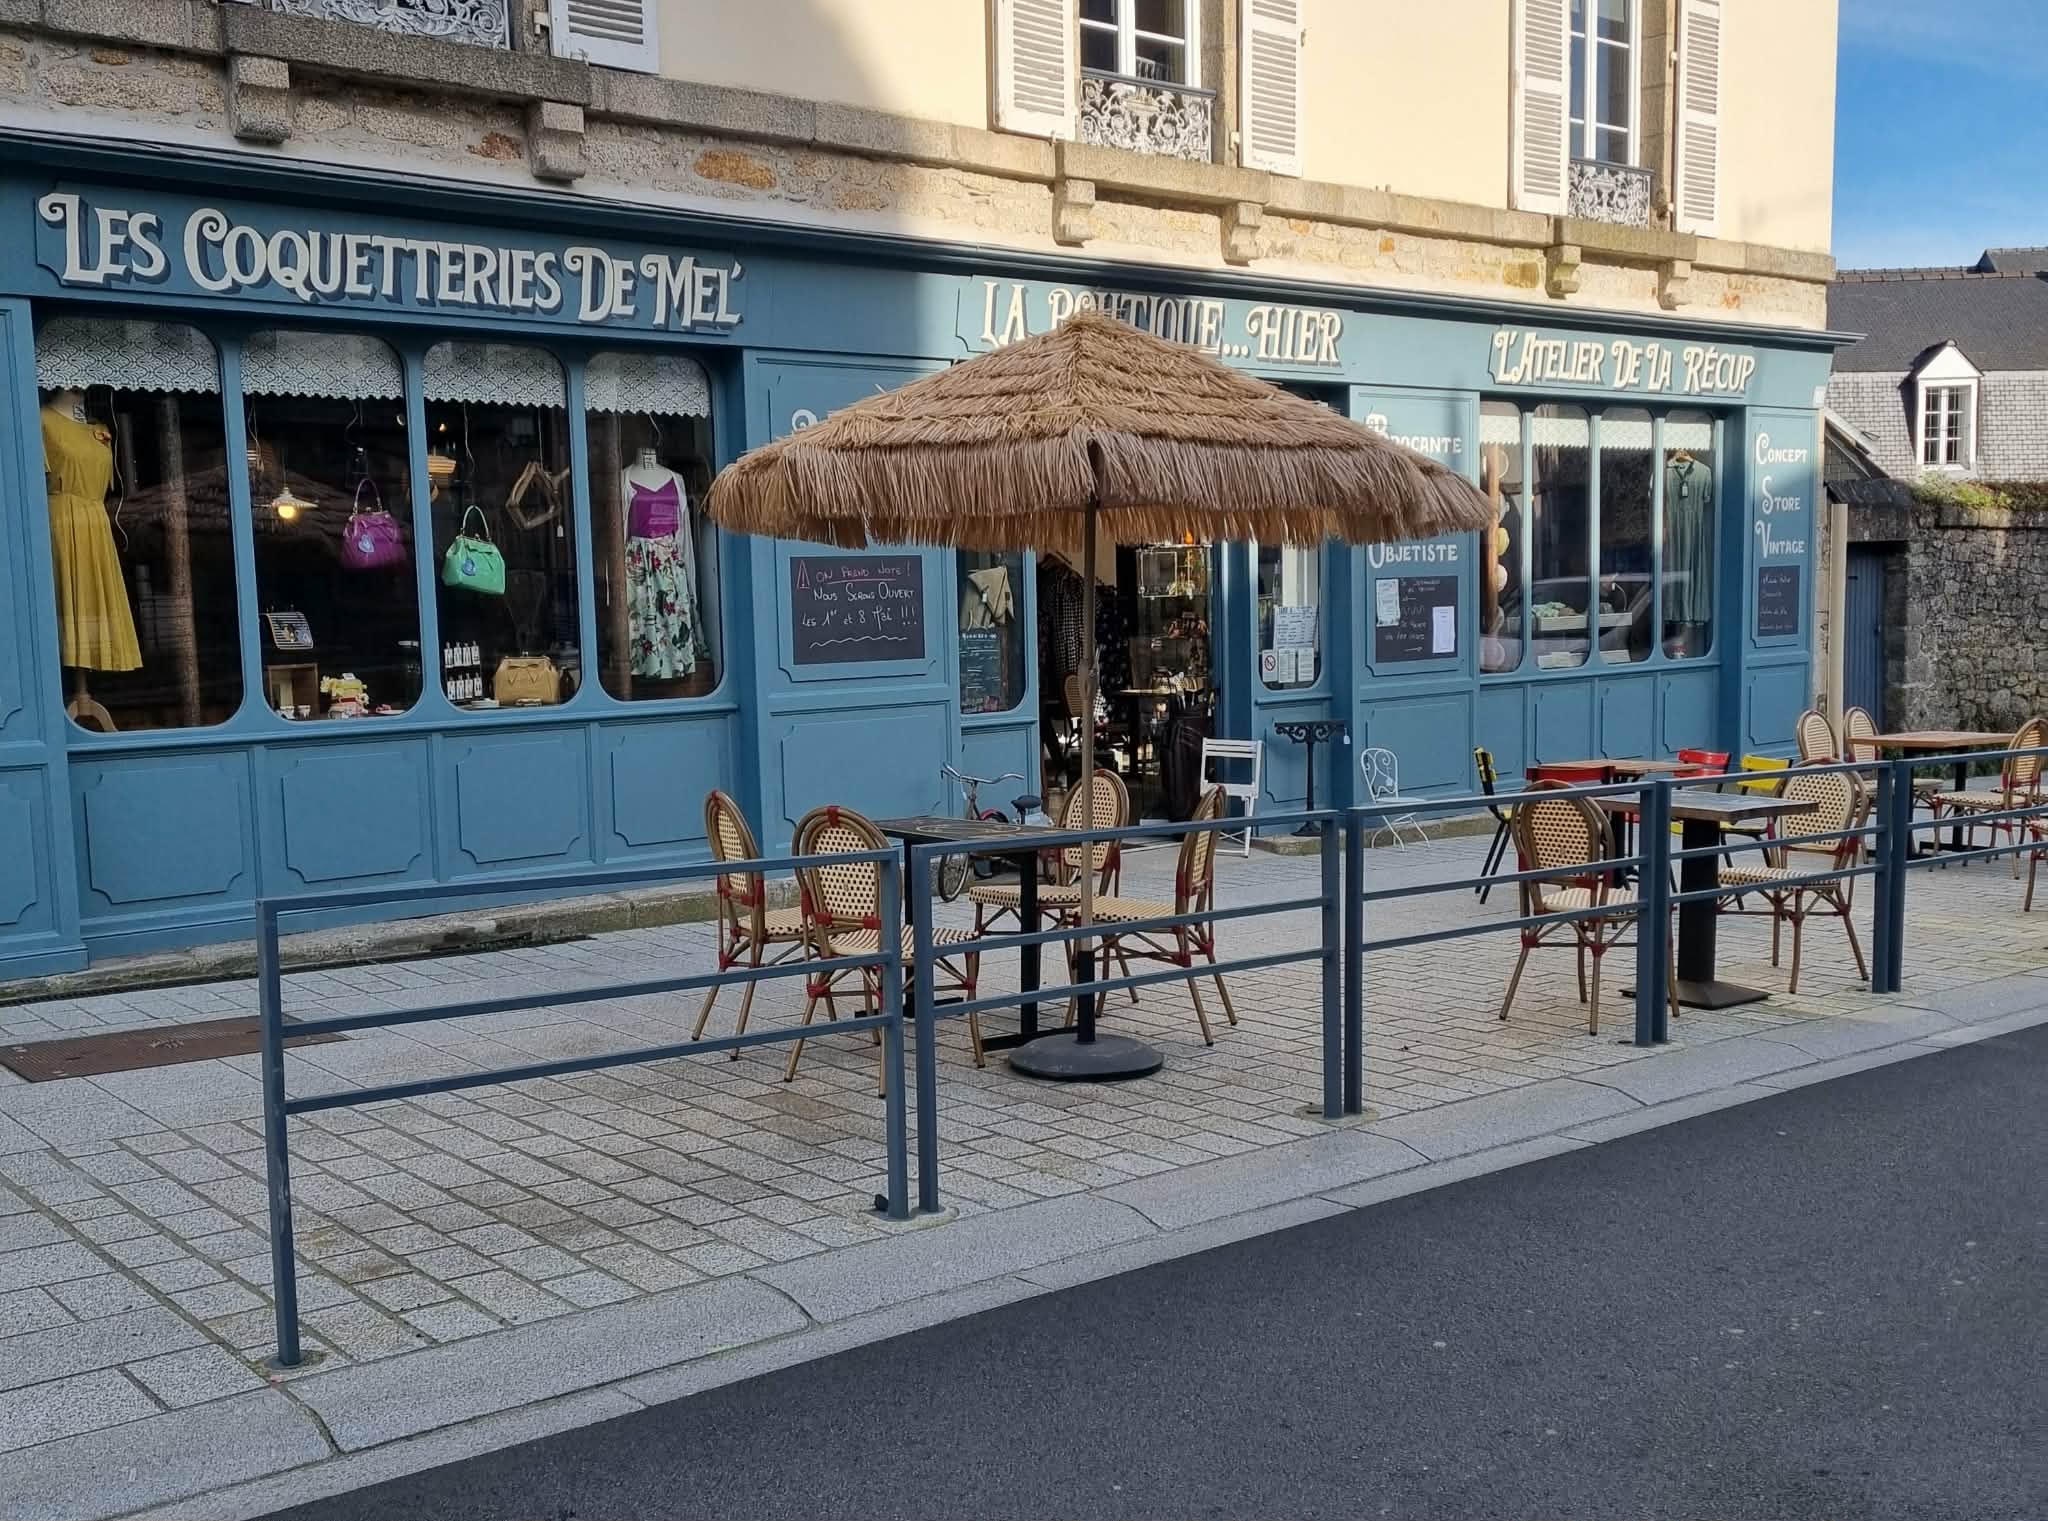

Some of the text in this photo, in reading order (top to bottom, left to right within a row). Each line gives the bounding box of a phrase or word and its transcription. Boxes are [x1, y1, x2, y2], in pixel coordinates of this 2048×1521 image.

[39, 193, 166, 283] LES
[184, 208, 562, 310] COQUETTERIES
[563, 246, 636, 321] DE
[981, 281, 1026, 346] LA
[1246, 305, 1343, 362] HIER
[1494, 331, 1756, 393] L'ATELIER DE LA RÉCUP
[1755, 432, 1808, 465] CONCEPT
[1762, 475, 1801, 515] STORE
[1755, 519, 1805, 559] VINTAGE
[859, 609, 866, 624] 8
